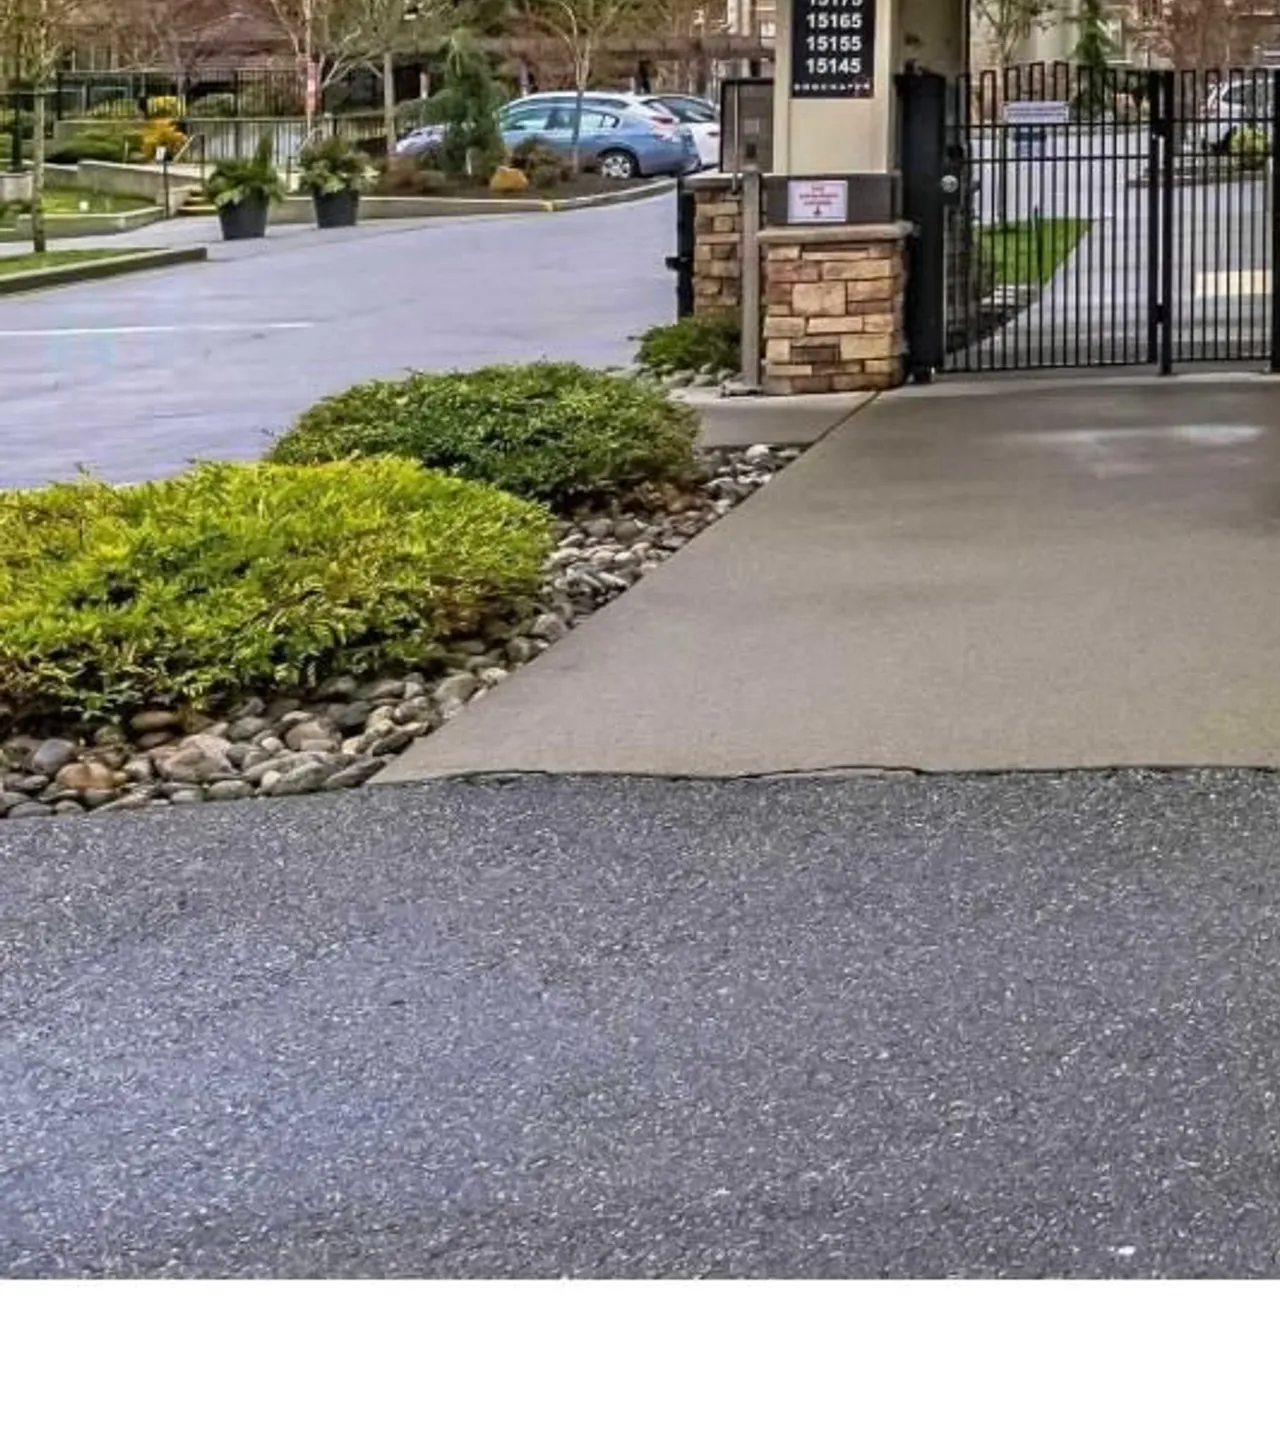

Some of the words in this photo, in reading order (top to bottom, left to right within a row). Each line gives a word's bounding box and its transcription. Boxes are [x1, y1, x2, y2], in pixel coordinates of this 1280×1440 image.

[806, 12, 862, 29] 15165
[806, 35, 862, 52] 15155
[805, 57, 861, 74] 15145
